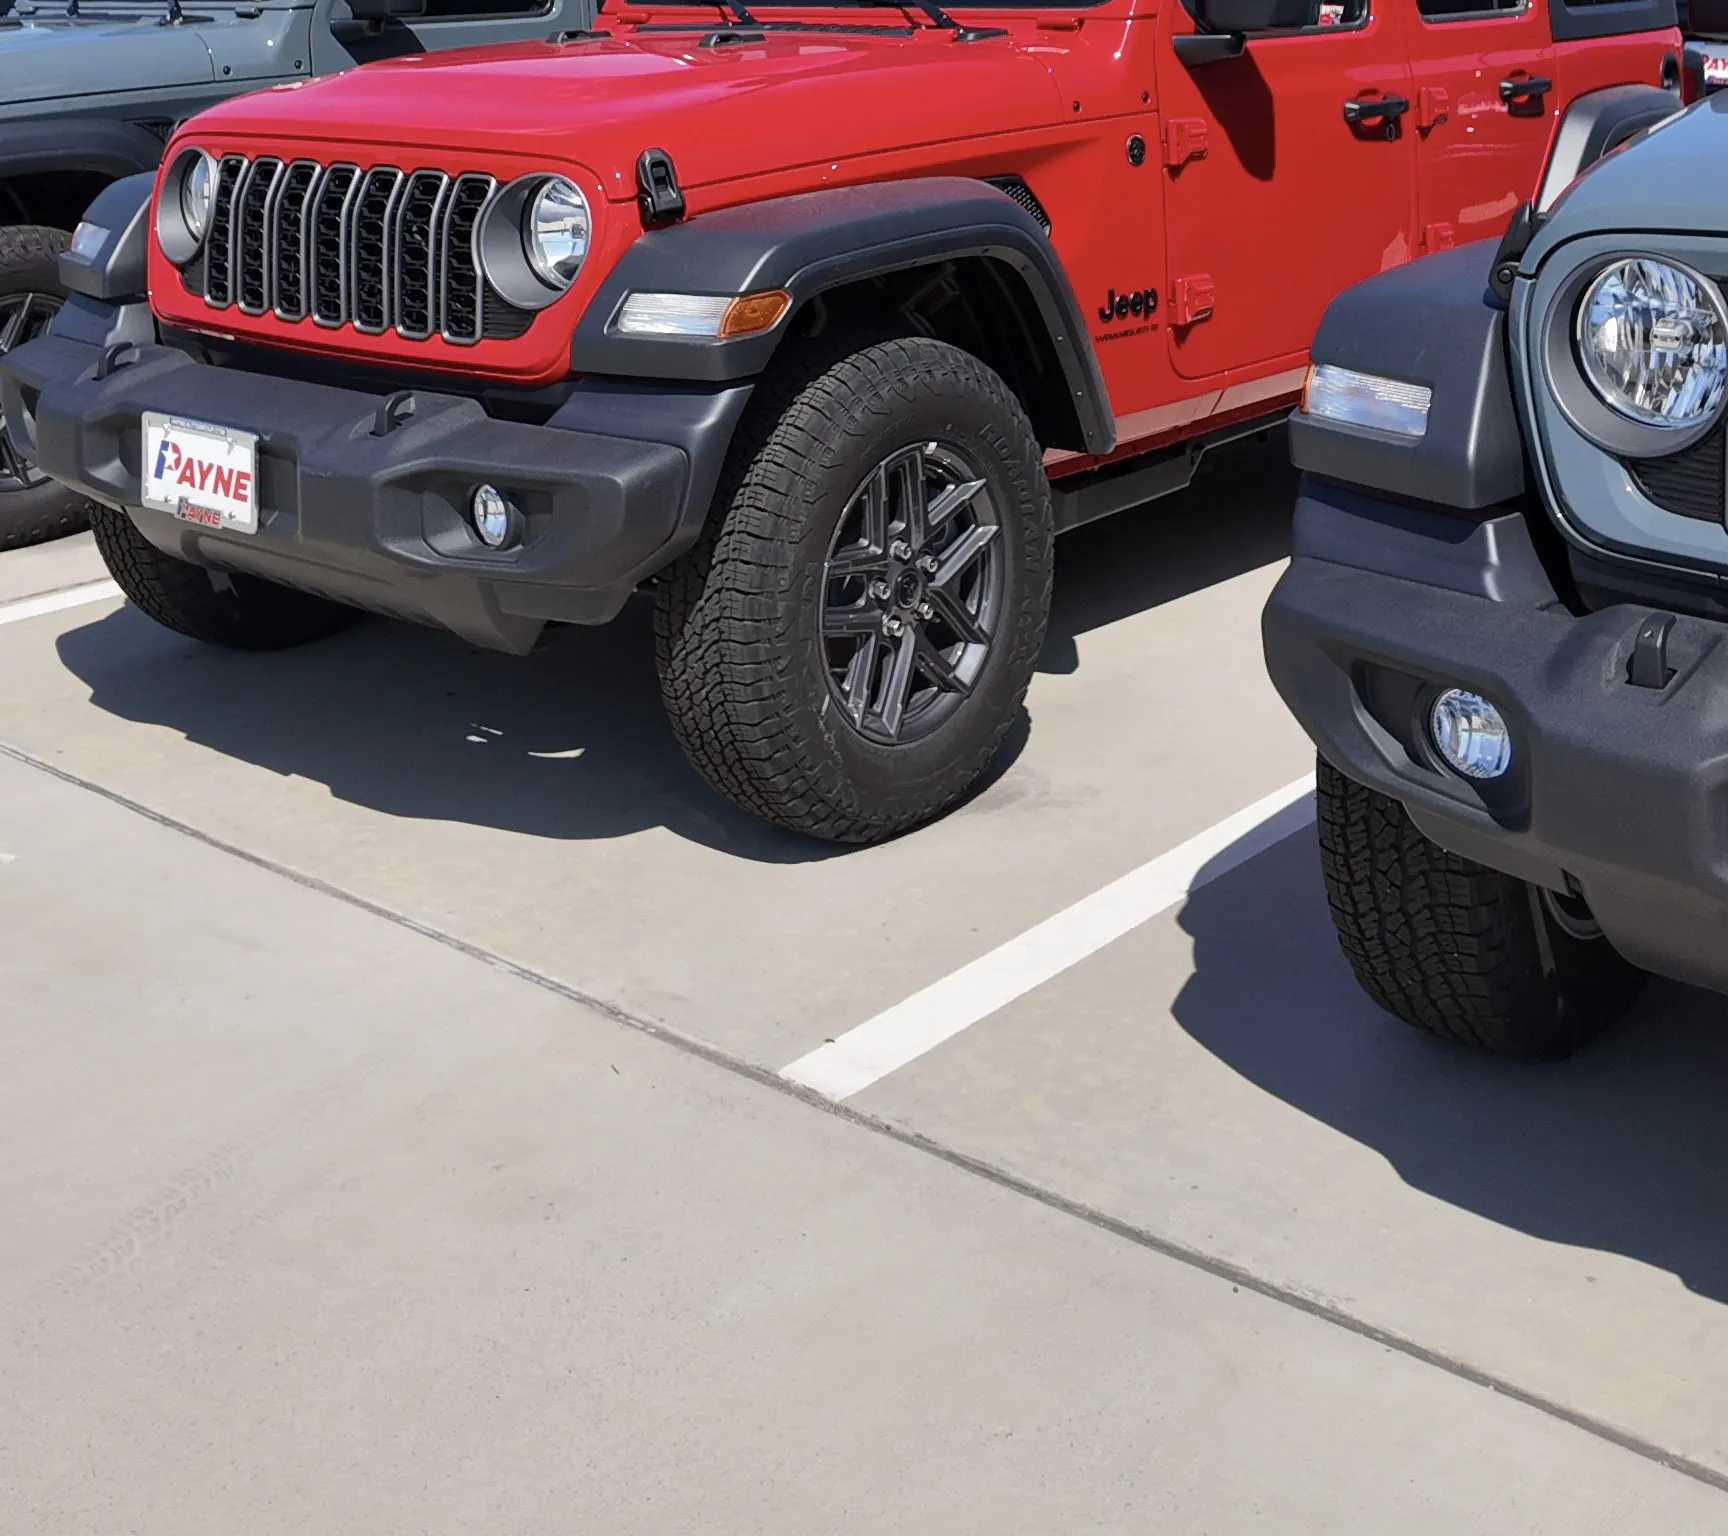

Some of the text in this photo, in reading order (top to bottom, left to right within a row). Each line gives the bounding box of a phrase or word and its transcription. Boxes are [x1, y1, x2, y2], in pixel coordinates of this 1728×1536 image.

[1098, 287, 1158, 324] Jeep
[153, 439, 252, 503] PAYNE
[176, 496, 221, 526] PAYNE
